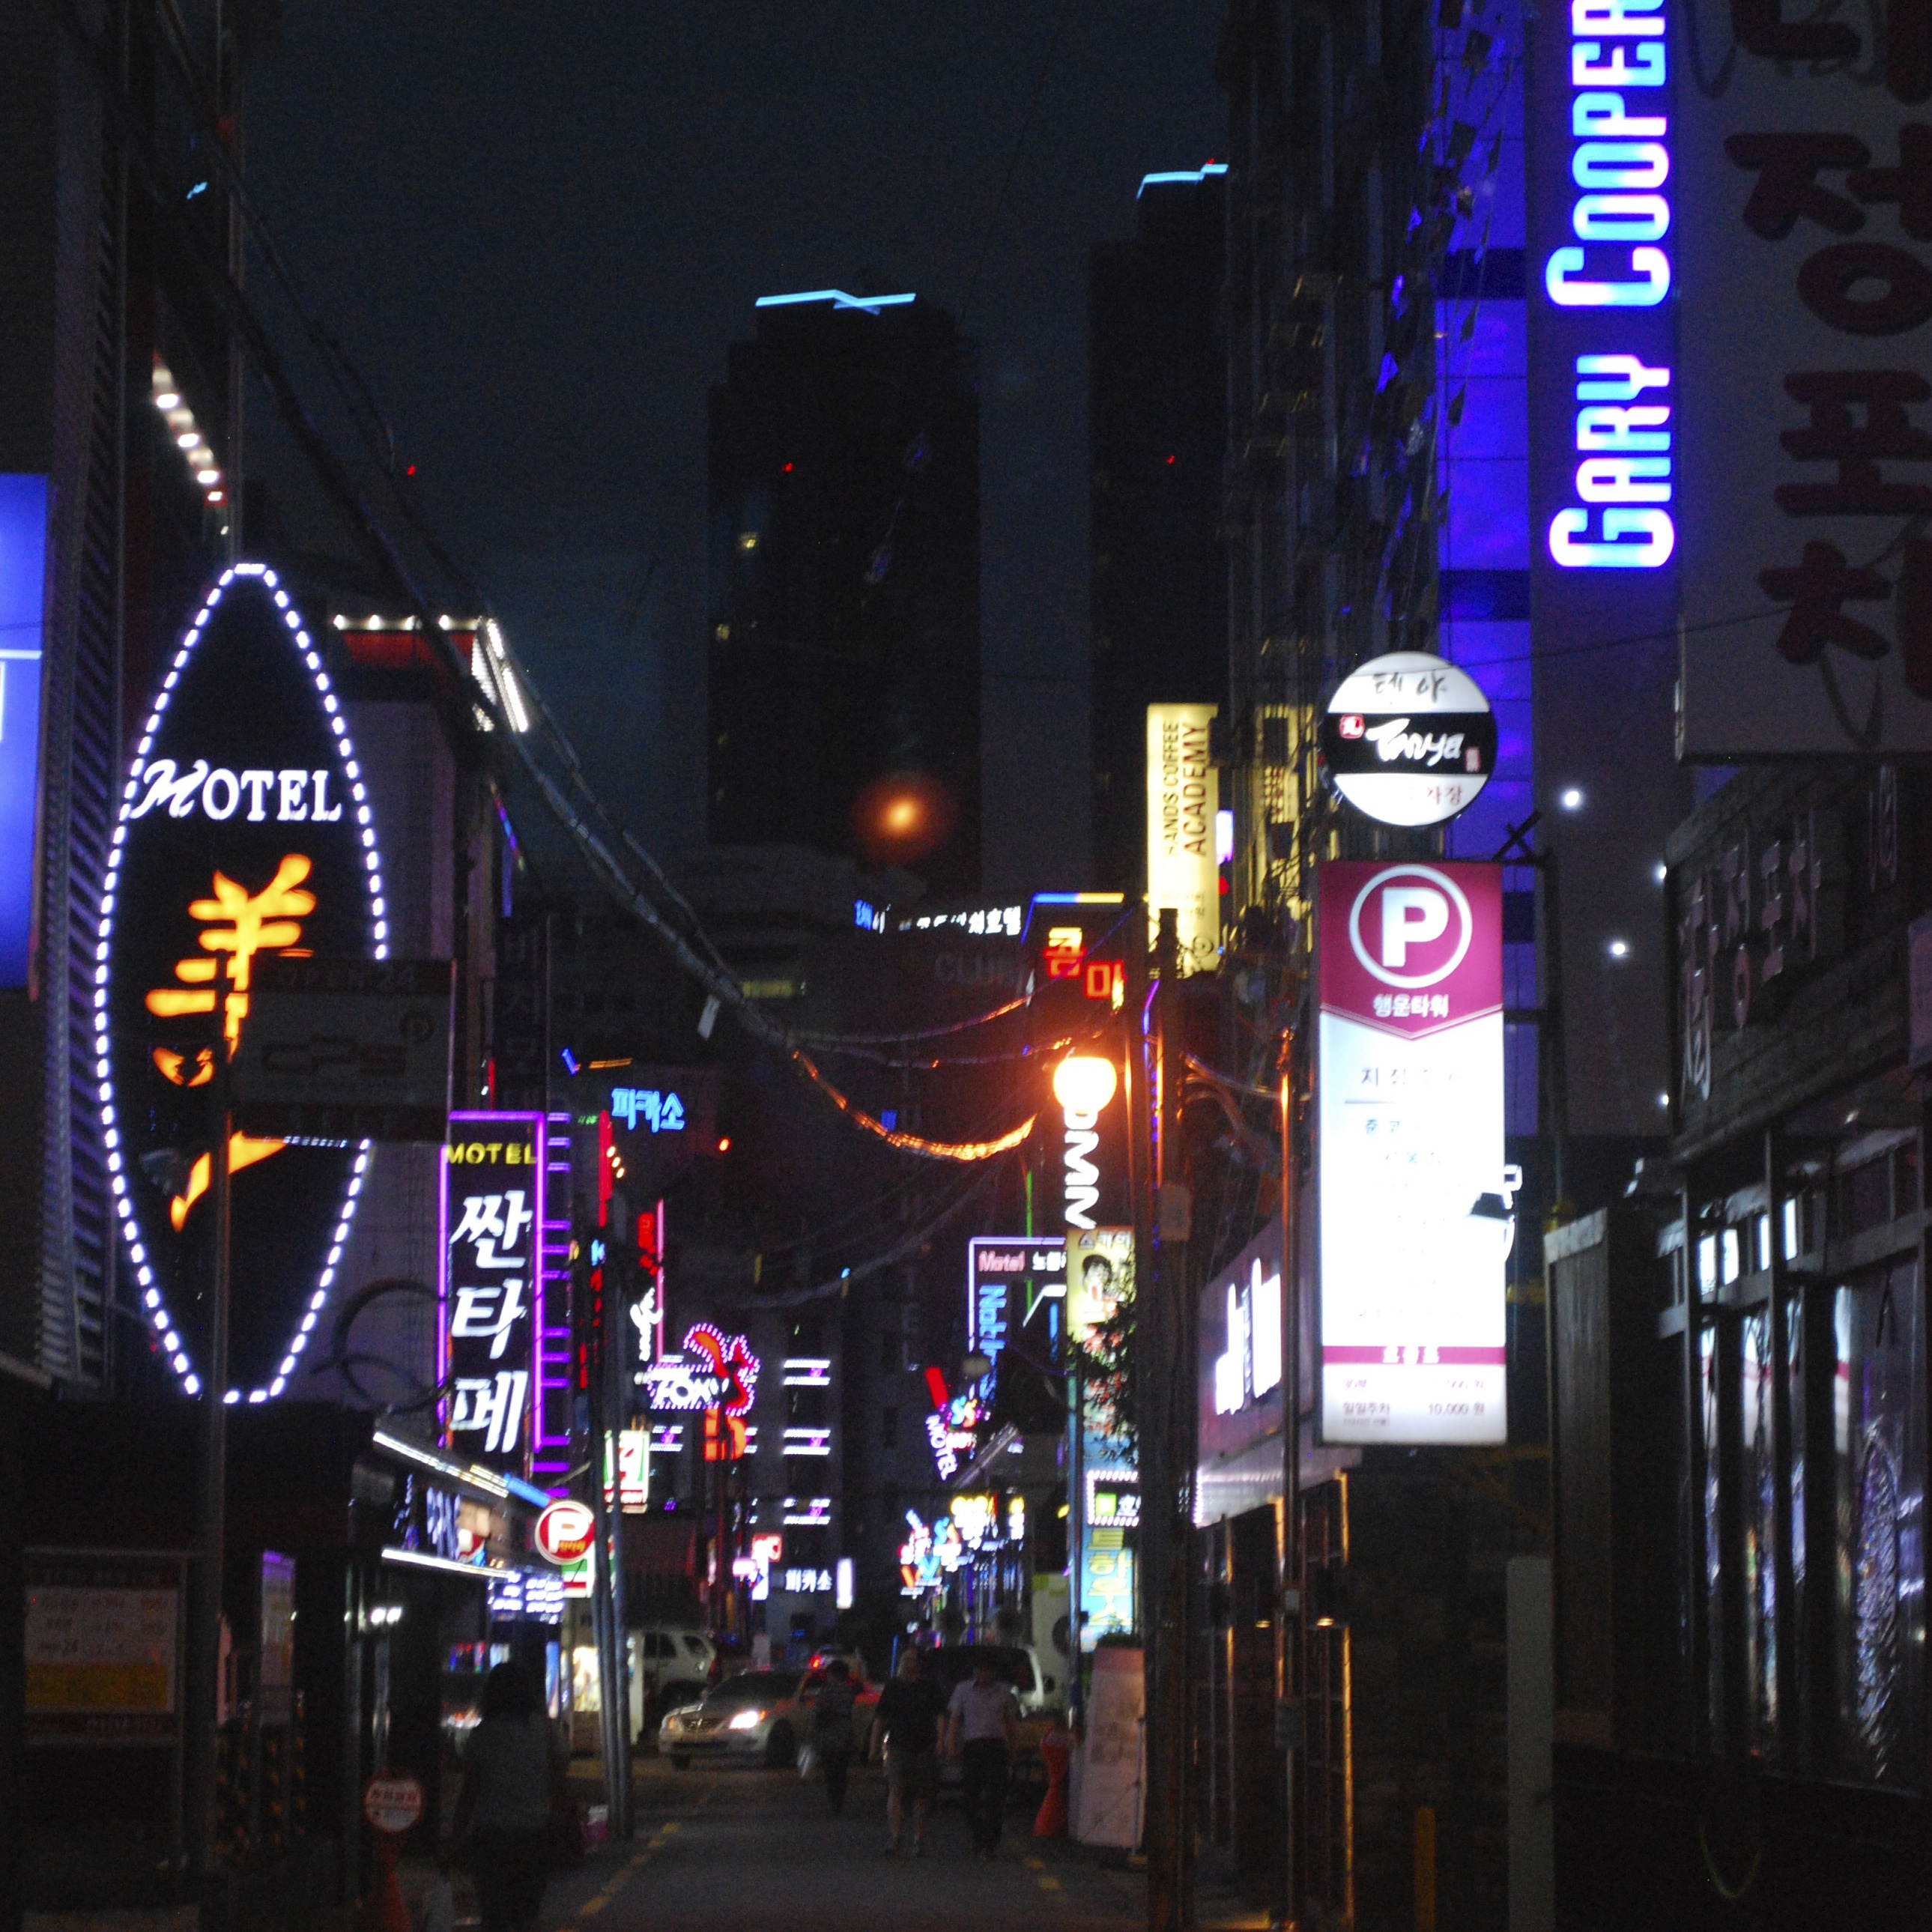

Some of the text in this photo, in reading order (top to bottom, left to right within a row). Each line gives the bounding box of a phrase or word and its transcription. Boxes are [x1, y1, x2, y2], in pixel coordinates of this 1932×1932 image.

[1548, 354, 1675, 567] GARY
[1162, 721, 1179, 787] COFFEE
[130, 758, 342, 822] MOTEL
[1181, 721, 1207, 857] ACADEMY
[1382, 887, 1449, 967] P
[612, 1088, 685, 1133] 피카소
[448, 1143, 537, 1164] MOTEL
[978, 1251, 1026, 1272] Motel
[450, 1190, 533, 1453] 싼타페
